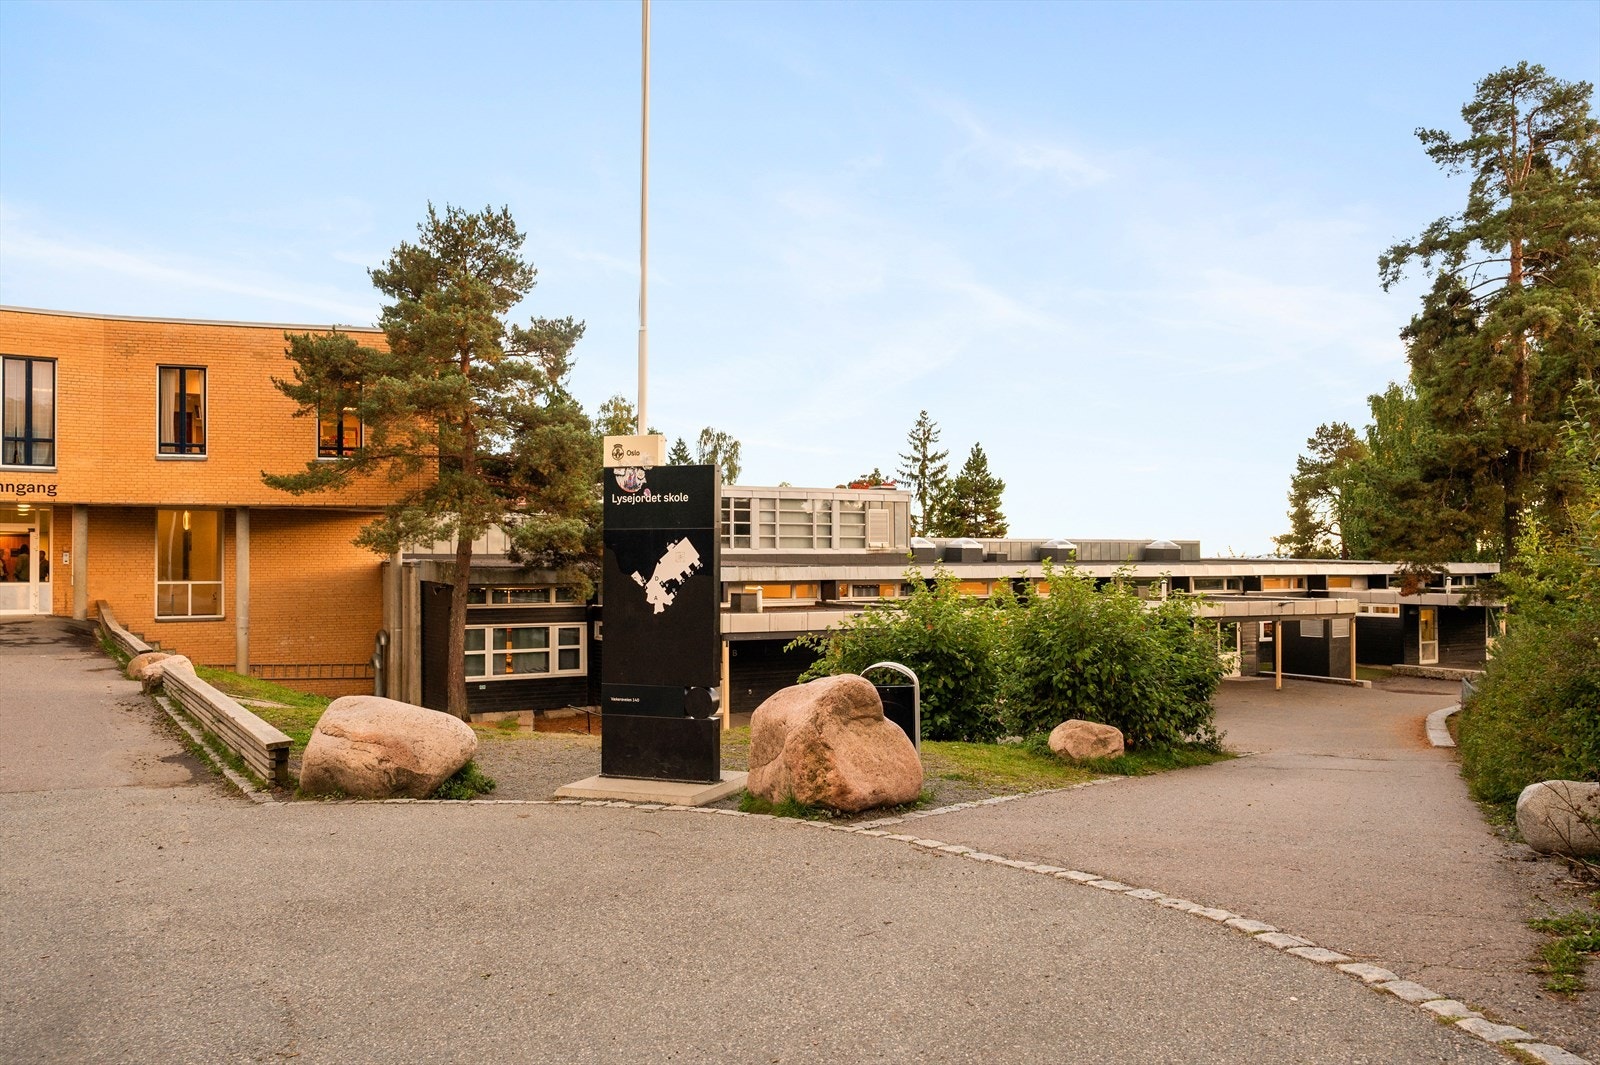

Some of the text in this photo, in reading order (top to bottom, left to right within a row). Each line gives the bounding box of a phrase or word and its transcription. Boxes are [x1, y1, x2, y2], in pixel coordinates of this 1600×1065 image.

[626, 449, 641, 457] Oslo
[611, 492, 689, 505] Lysejordet skole
